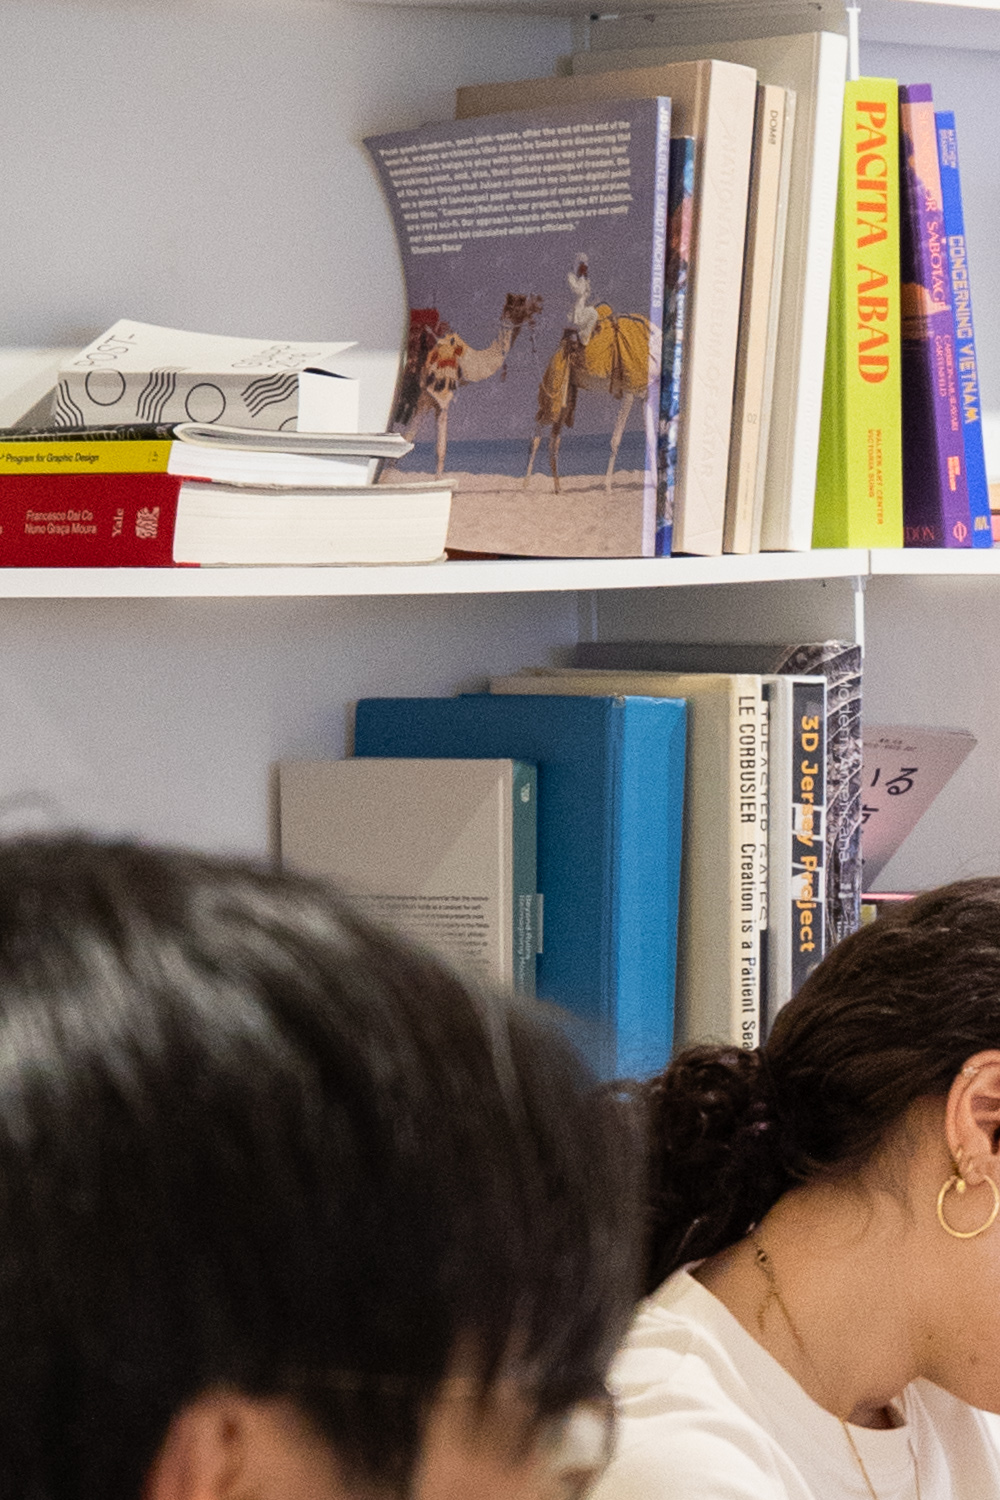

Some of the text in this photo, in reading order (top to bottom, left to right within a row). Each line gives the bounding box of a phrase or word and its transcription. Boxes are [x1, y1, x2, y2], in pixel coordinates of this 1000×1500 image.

[855, 100, 891, 384] PACITA ABAD
[926, 220, 951, 313] SABOTAGE
[948, 234, 981, 425] CONCERNING VIETNAM
[6, 452, 100, 465] Program for Graphic Design
[24, 522, 46, 535] Nuno
[71, 523, 98, 535] Moura
[26, 509, 67, 522] Francesco
[111, 507, 125, 538] Yale
[737, 694, 756, 717] LE
[738, 722, 757, 825] CORBUSIER
[796, 714, 820, 955] 3D Jersey Project
[740, 842, 757, 915] Creation
[741, 921, 755, 935] is
[741, 956, 757, 1015] Patient
